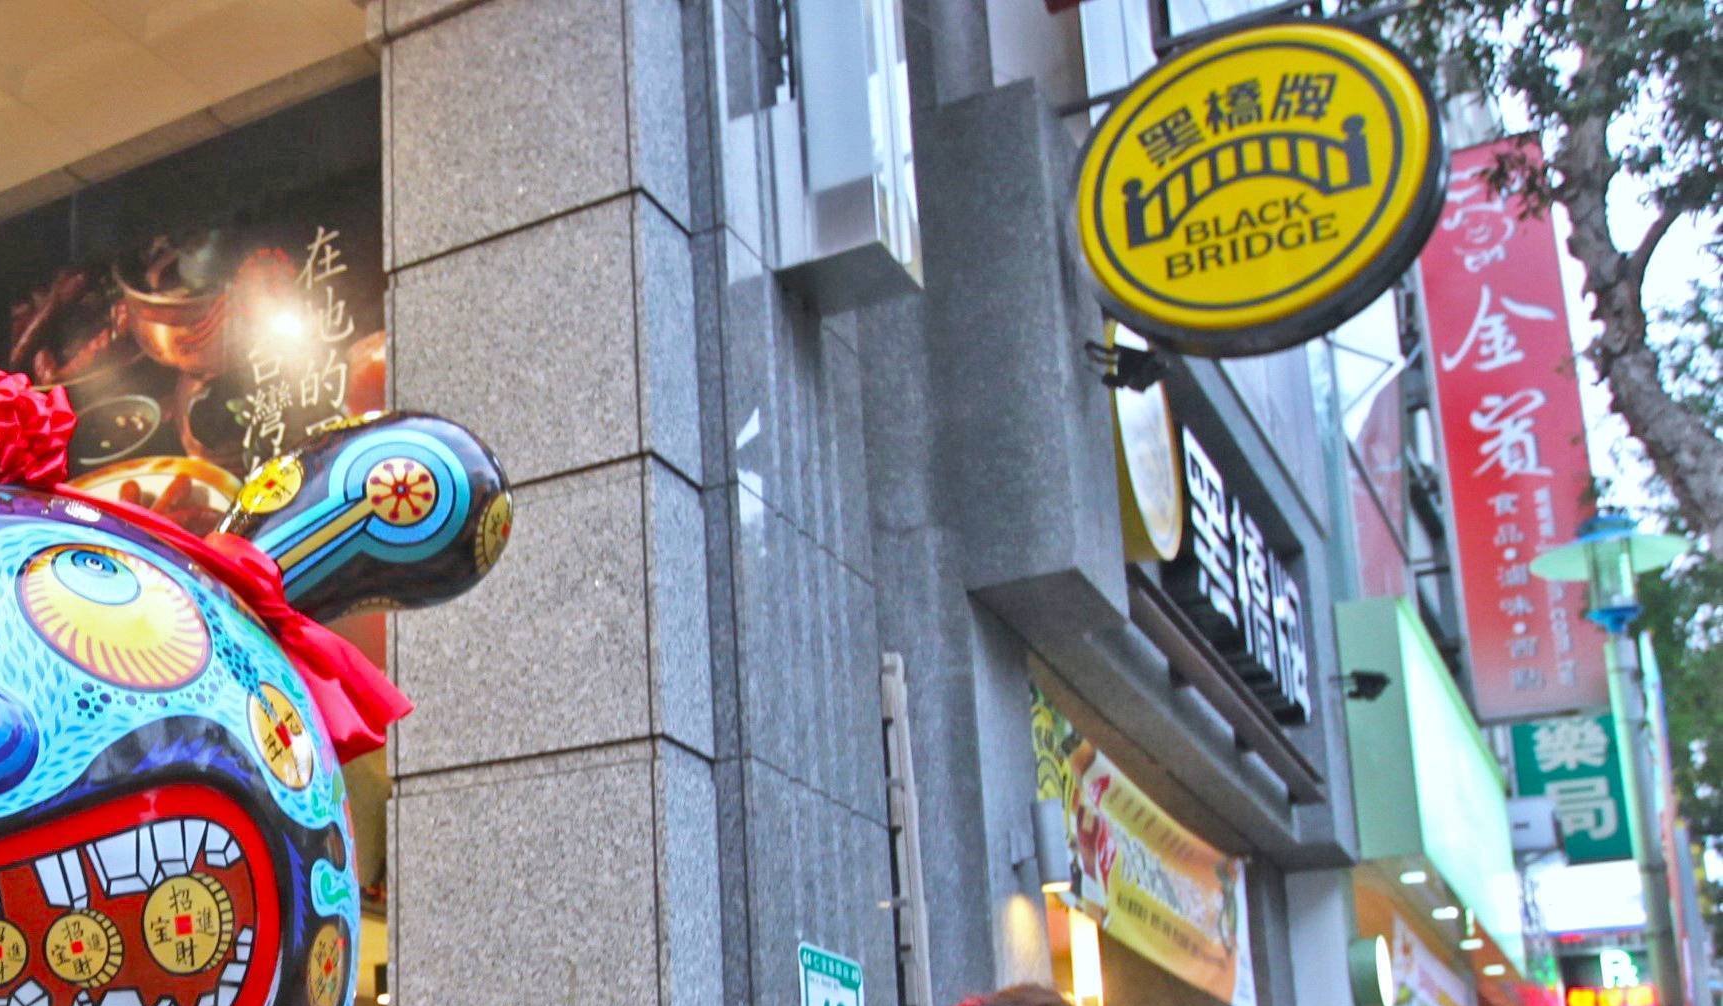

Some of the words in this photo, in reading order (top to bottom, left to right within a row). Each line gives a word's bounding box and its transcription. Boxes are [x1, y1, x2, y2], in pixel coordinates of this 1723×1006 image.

[1136, 73, 1338, 169] 黑橋牌
[1164, 212, 1340, 282] BRIDGE
[1185, 192, 1310, 247] BLACK
